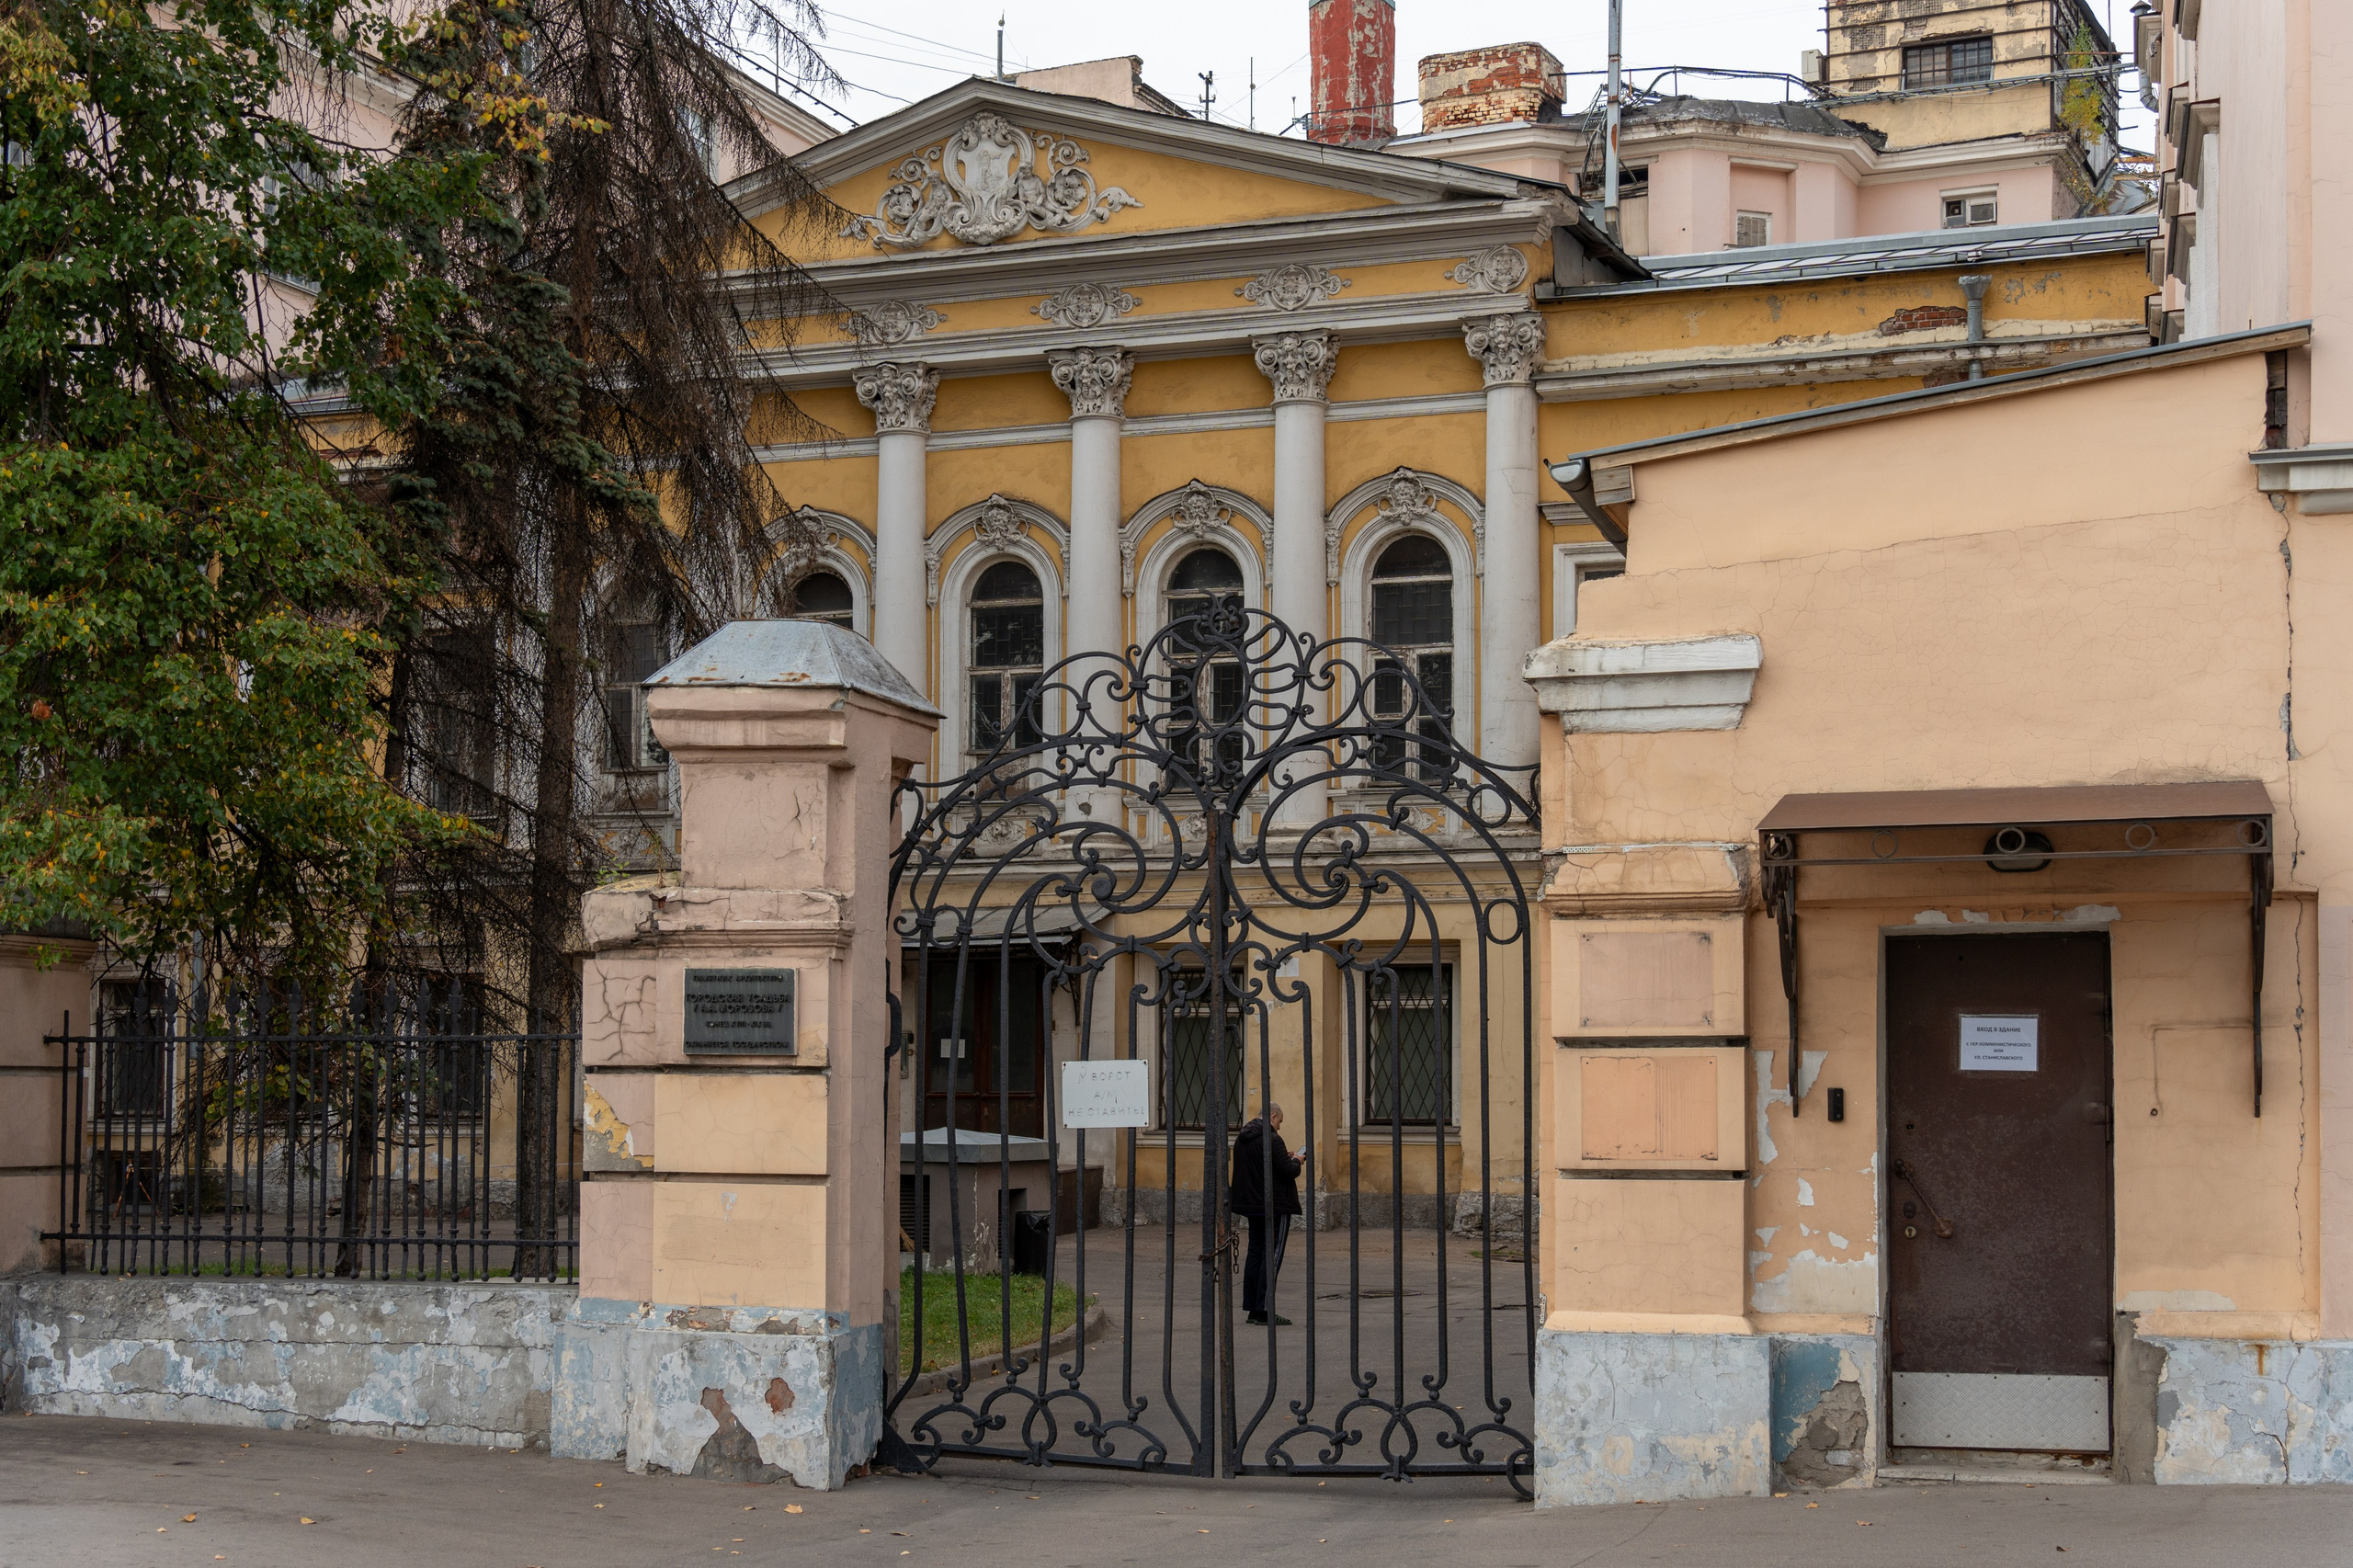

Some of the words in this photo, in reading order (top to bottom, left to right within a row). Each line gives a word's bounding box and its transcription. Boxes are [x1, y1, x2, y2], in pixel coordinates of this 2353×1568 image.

[687, 994, 744, 1003] ГОРОДСКАЯ
[748, 994, 791, 1003] УСАДЬБА
[719, 1004, 774, 1013] МОРОЗОВА
[1092, 1071, 1131, 1082] ВОРОТ
[1068, 1108, 1083, 1117] НЕ
